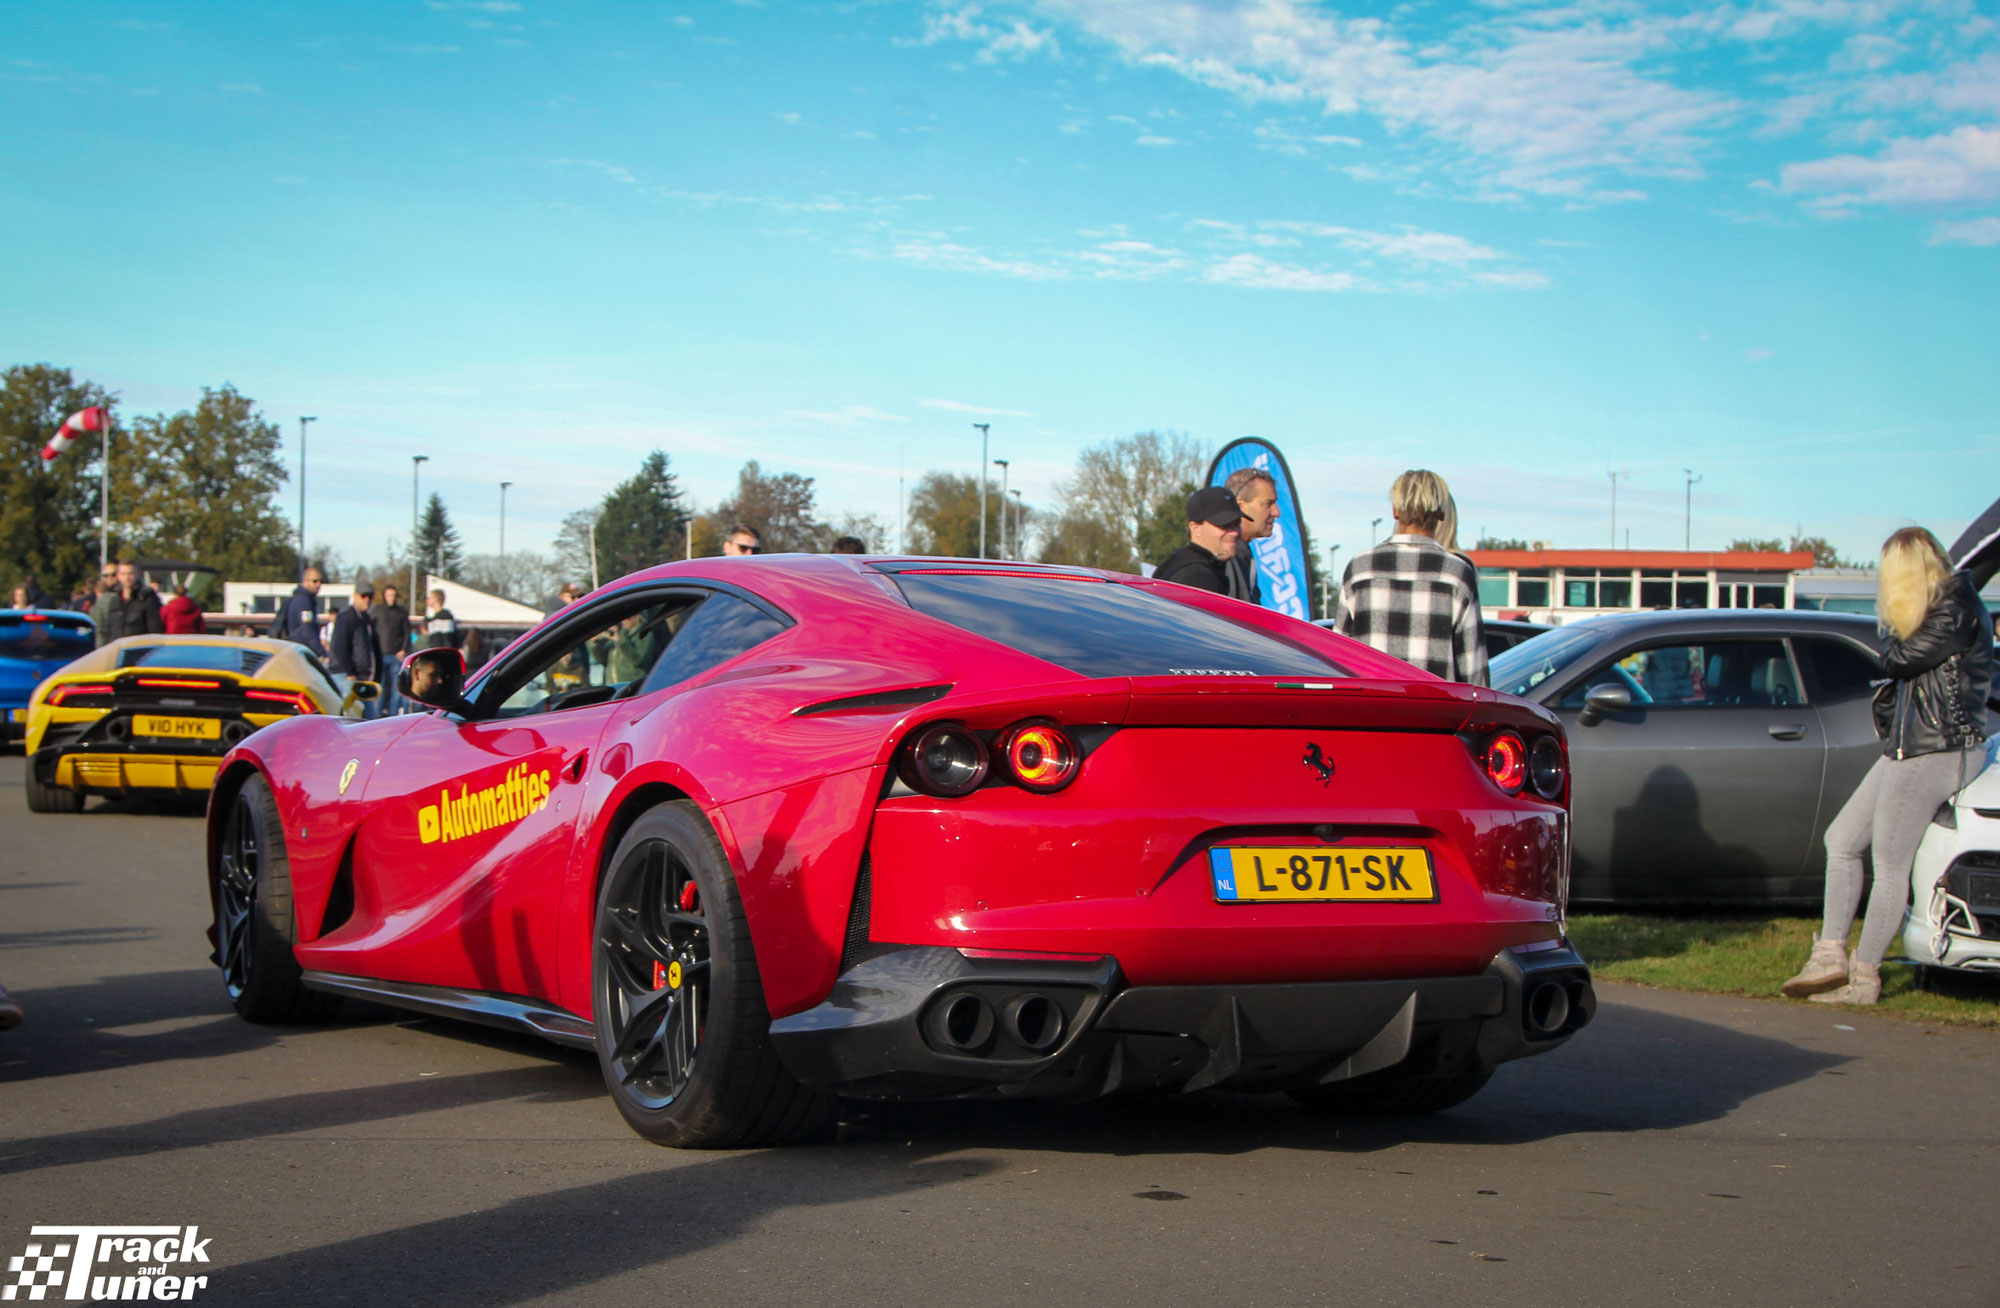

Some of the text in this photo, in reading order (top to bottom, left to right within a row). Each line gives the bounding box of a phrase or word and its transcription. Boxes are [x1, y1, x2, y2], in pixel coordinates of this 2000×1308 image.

[175, 720, 205, 735] HYK
[441, 762, 550, 843] Automatties
[1218, 879, 1234, 891] NL
[1253, 855, 1412, 892] L-871-SK
